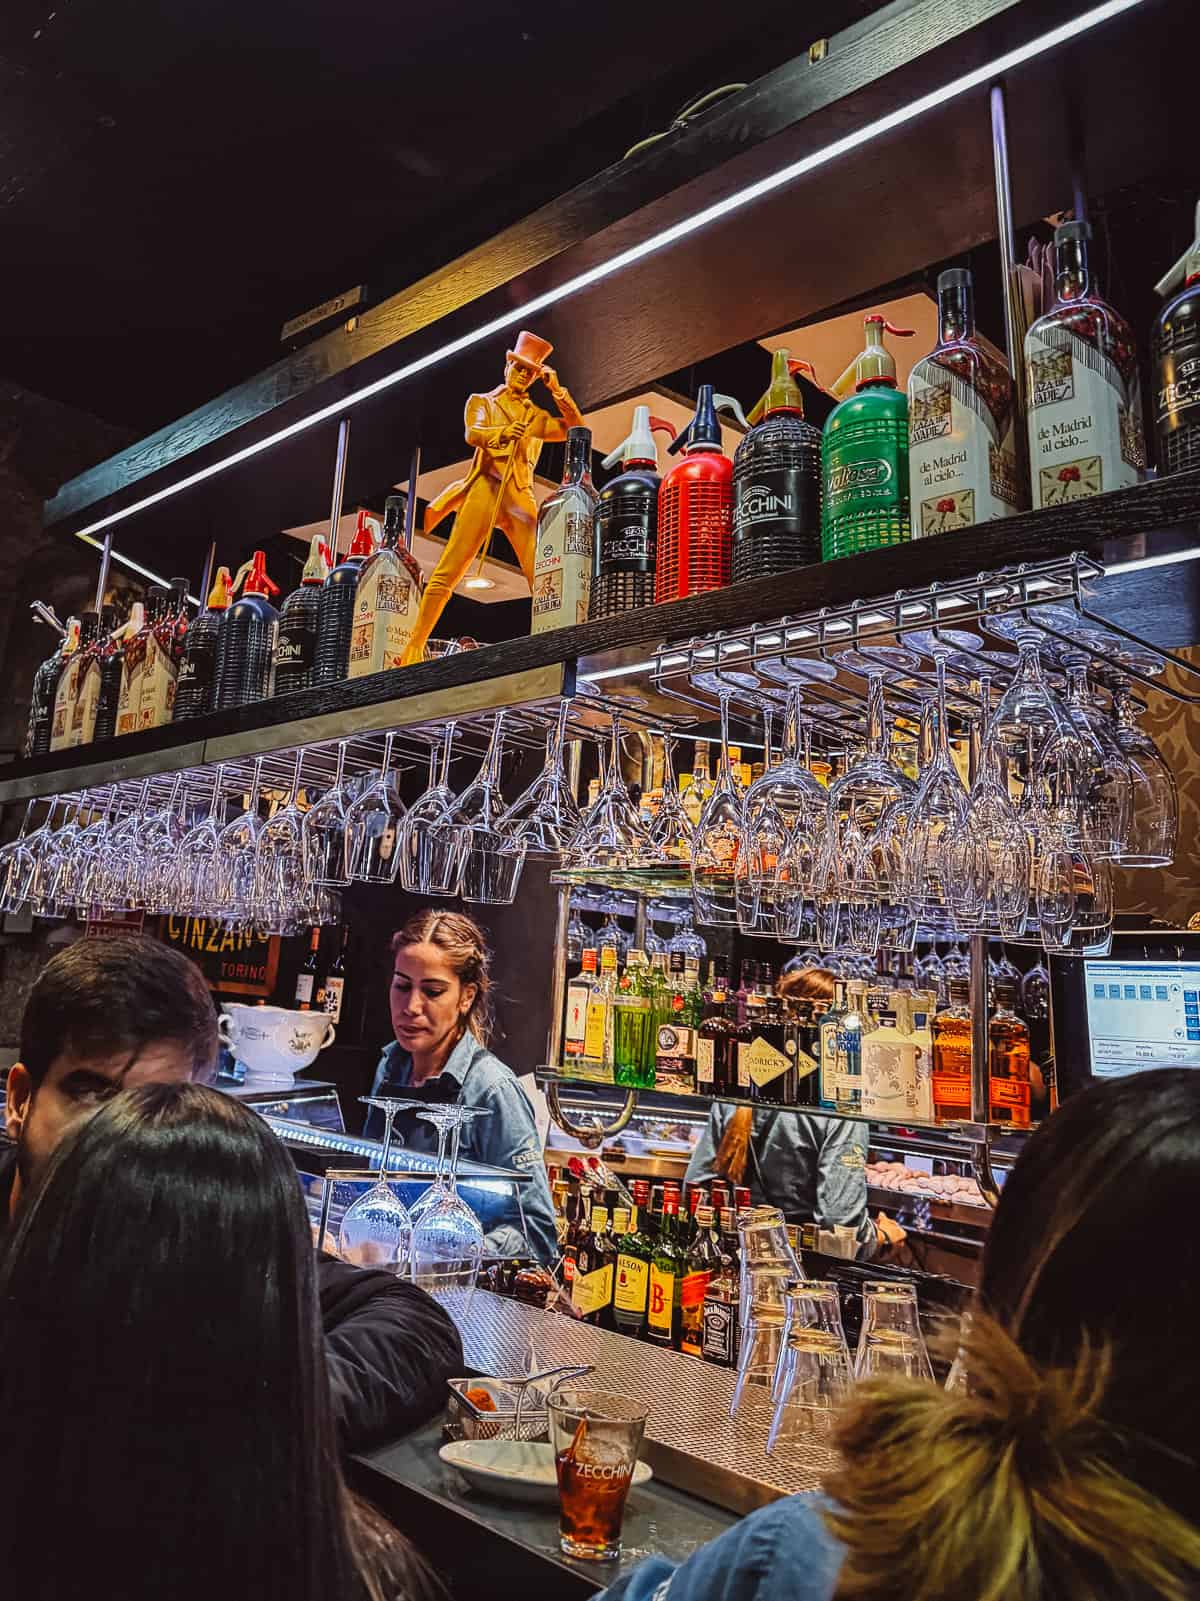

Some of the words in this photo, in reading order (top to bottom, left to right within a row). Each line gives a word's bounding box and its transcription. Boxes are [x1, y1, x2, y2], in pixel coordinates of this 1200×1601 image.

[1038, 426, 1050, 441] de
[1053, 416, 1092, 437] Madrid
[1042, 439, 1052, 453] al
[920, 462, 931, 474] de
[933, 450, 967, 470] Madrid
[924, 472, 933, 486] al
[651, 1282, 664, 1314] B
